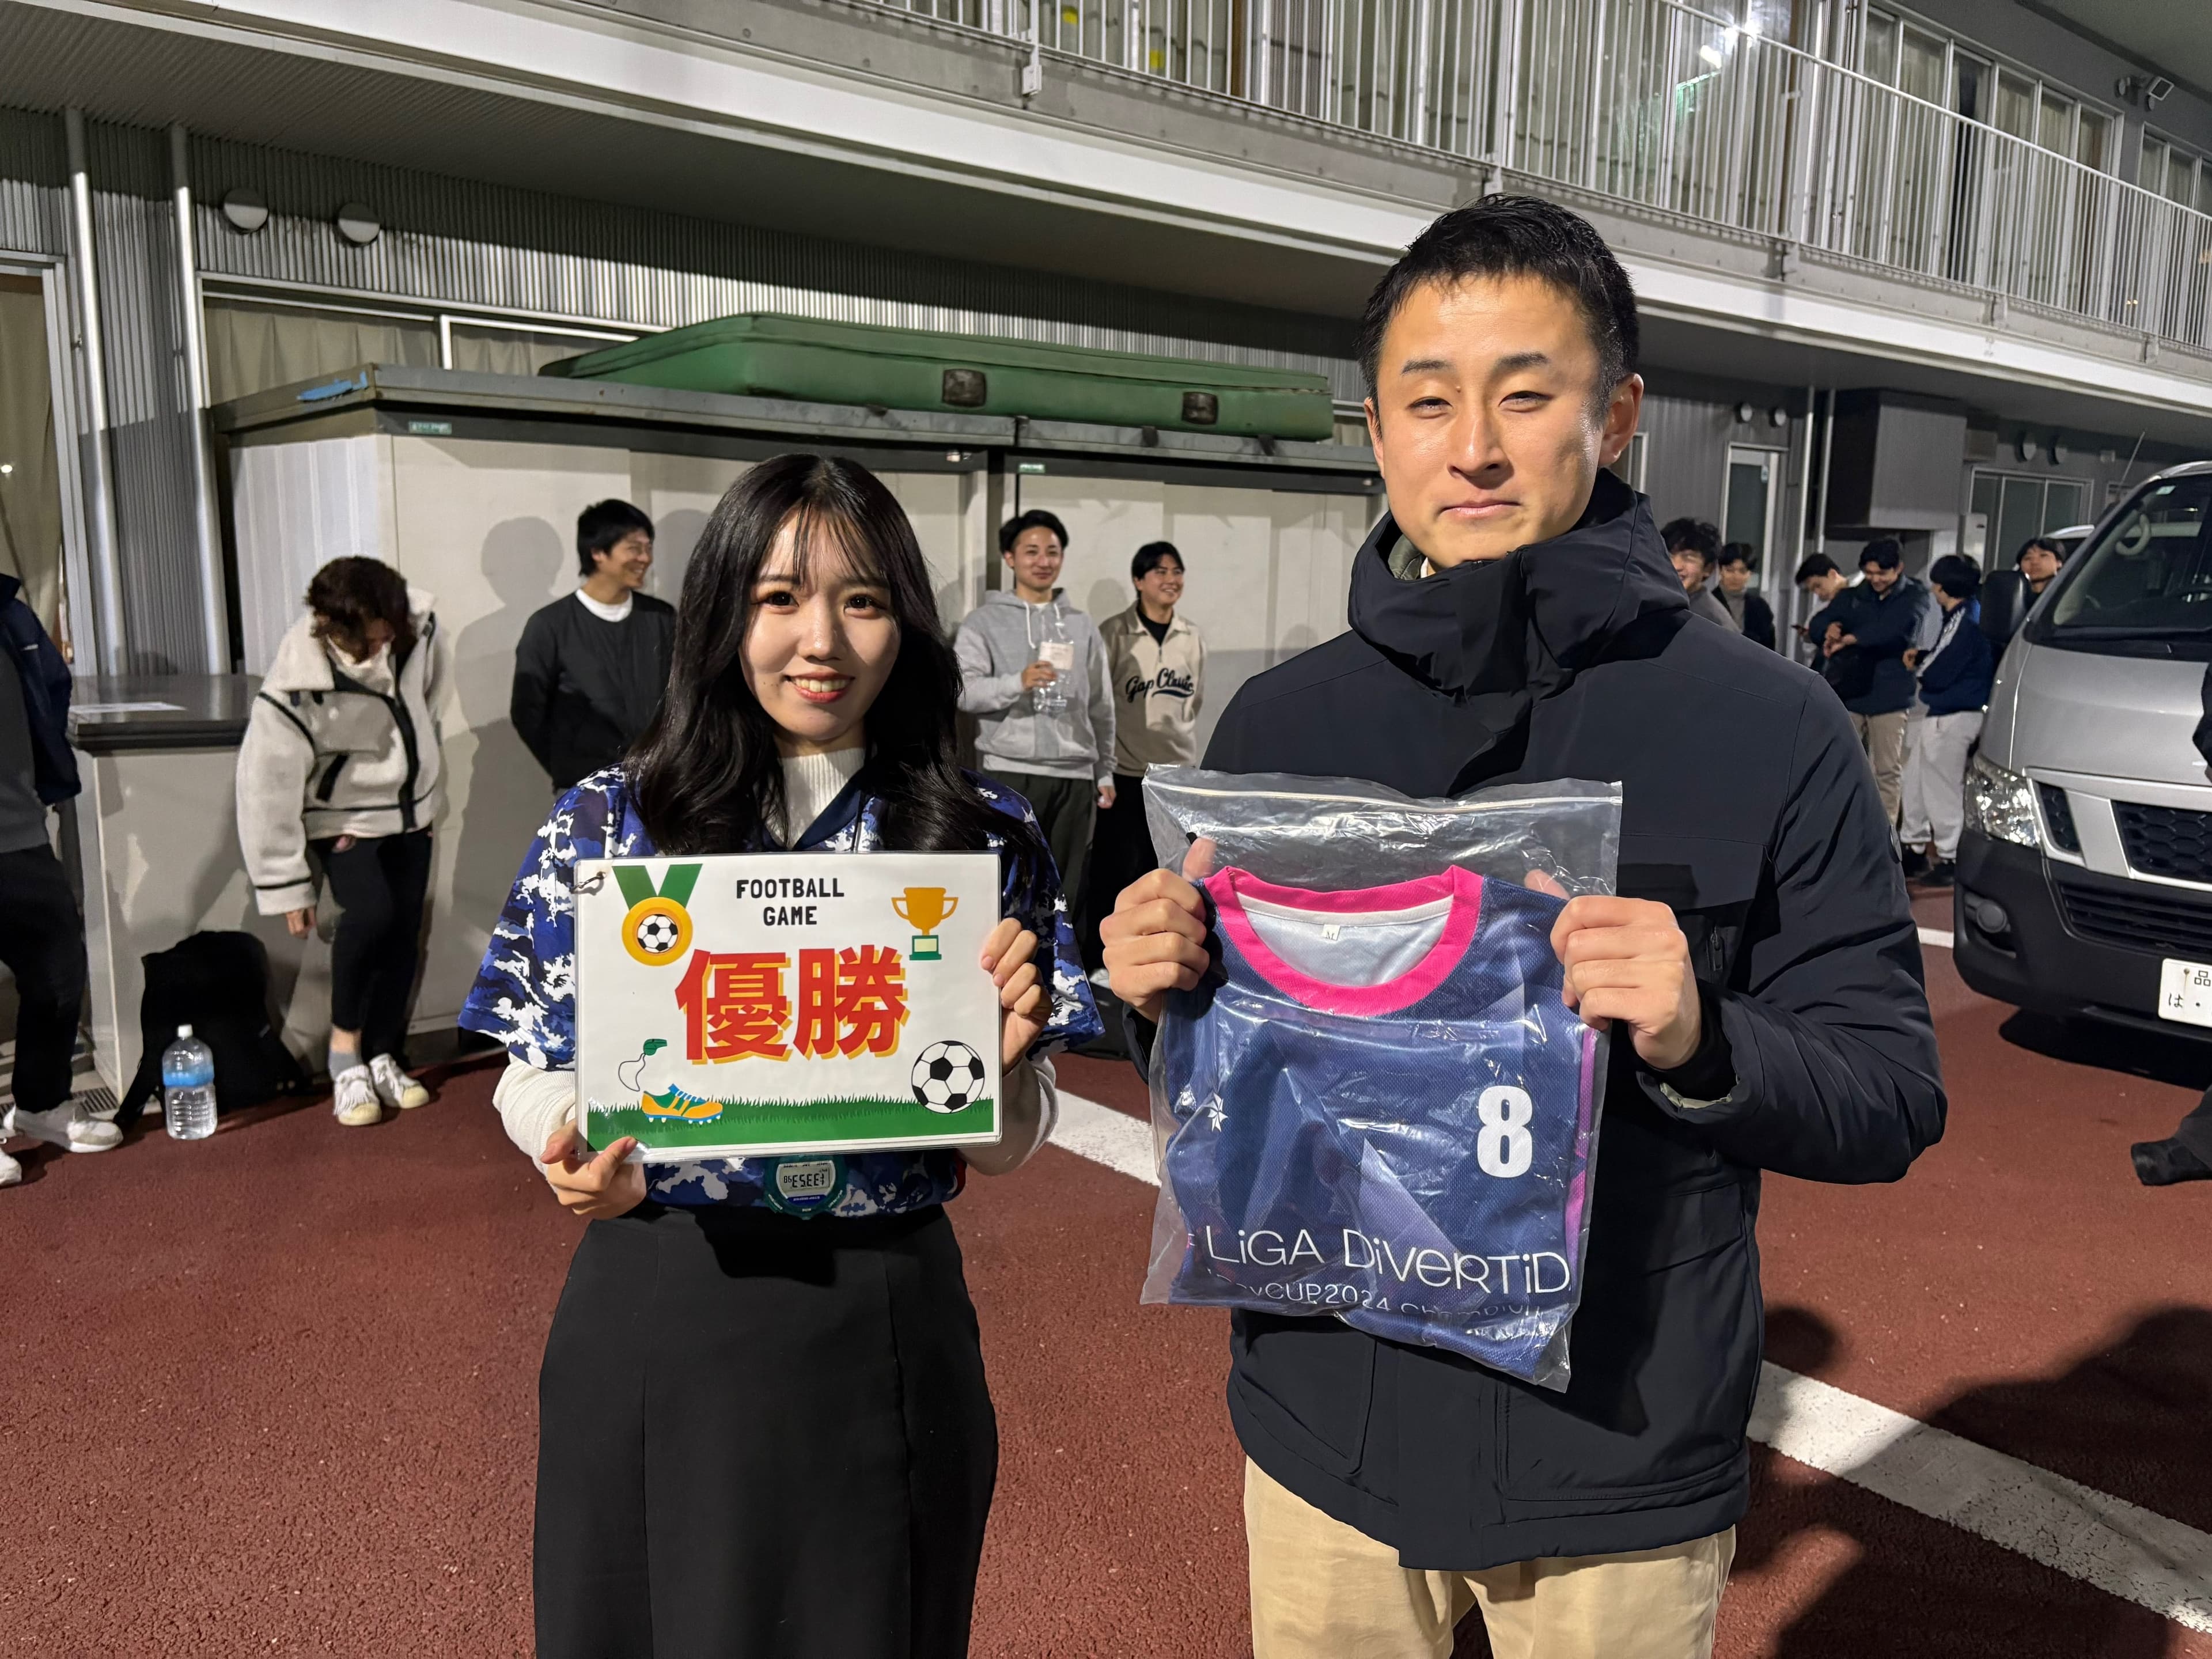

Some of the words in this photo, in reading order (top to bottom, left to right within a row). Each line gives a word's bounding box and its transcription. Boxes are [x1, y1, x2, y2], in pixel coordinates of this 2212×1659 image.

[1126, 676, 1154, 703] Gap
[736, 878, 844, 899] FOOTBALL
[763, 906, 817, 926] GAME
[675, 945, 908, 1063] 優勝
[1477, 1085, 1533, 1178] 8
[1206, 1225, 1325, 1266] LiGA
